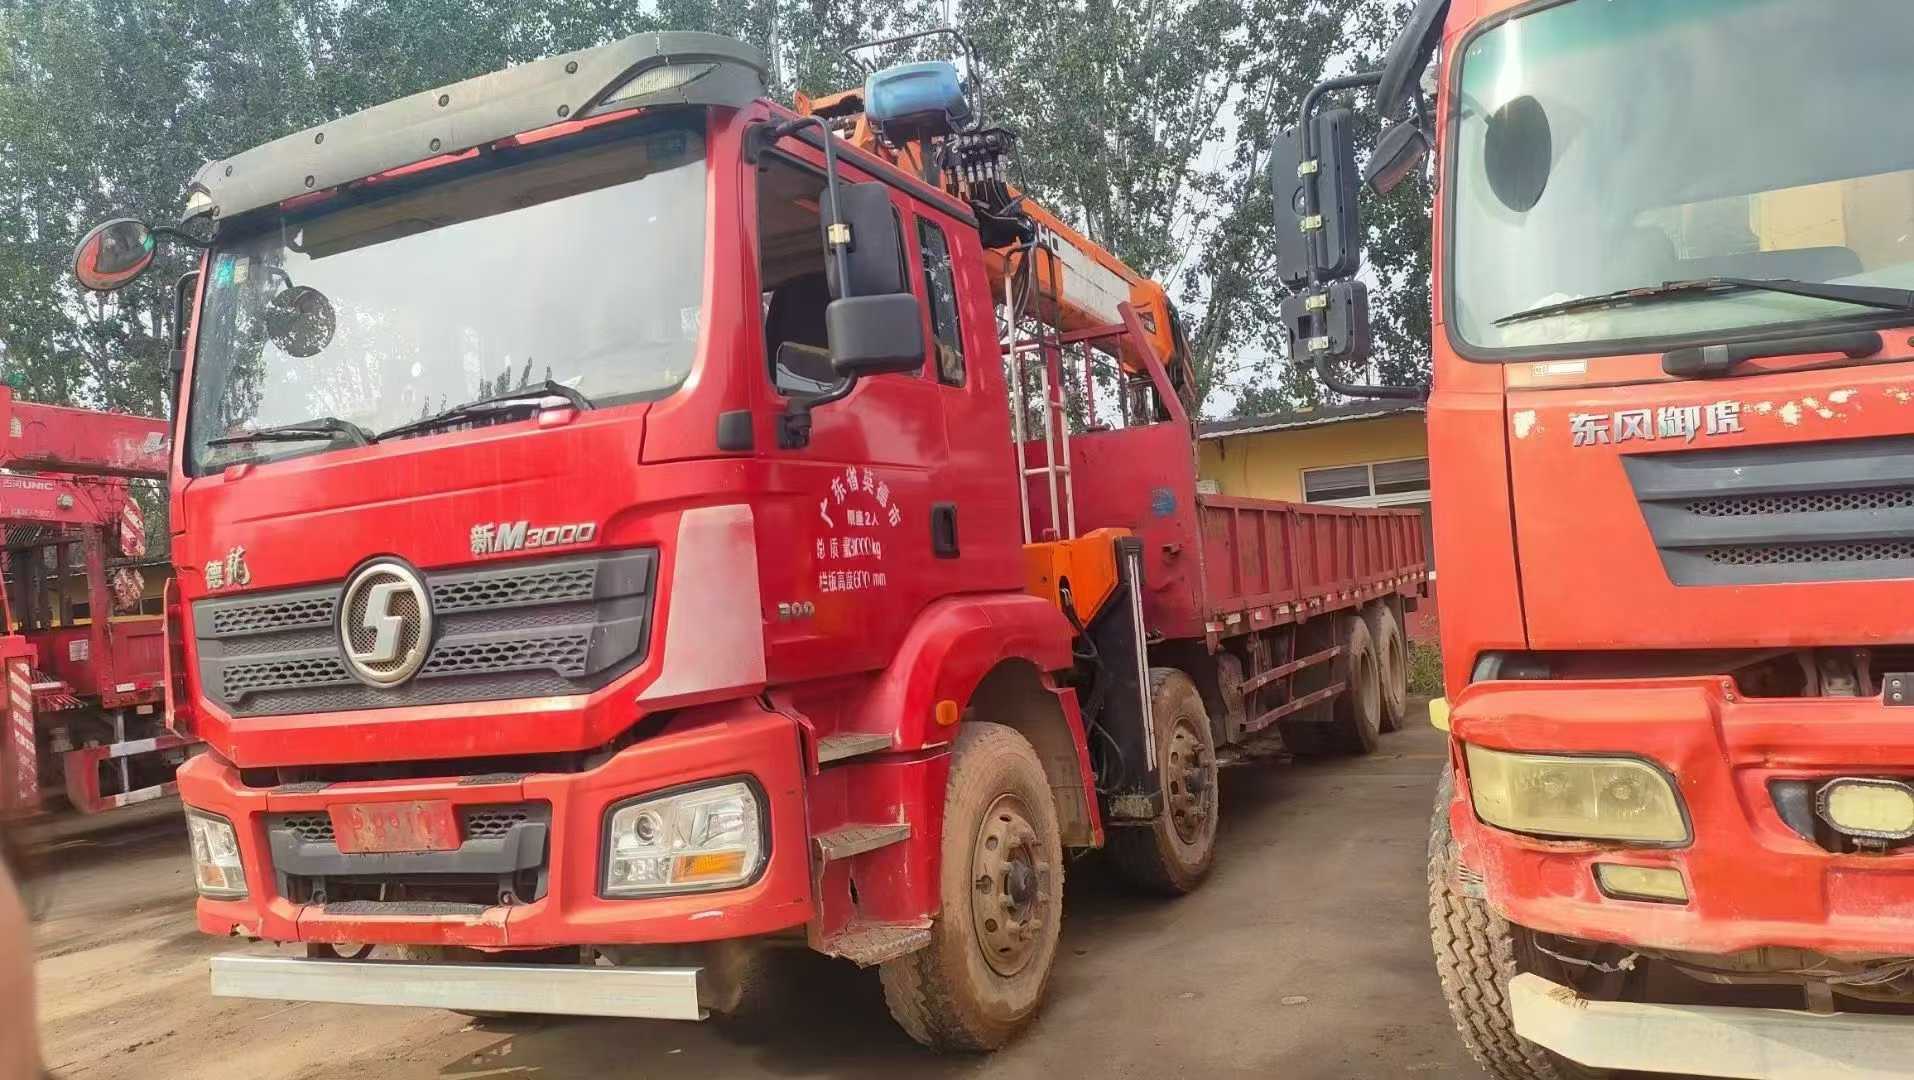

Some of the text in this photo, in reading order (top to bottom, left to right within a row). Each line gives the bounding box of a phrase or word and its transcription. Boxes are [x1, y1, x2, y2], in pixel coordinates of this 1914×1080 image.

[1569, 401, 1744, 446] 东风御虎
[470, 521, 596, 555] 新M3000
